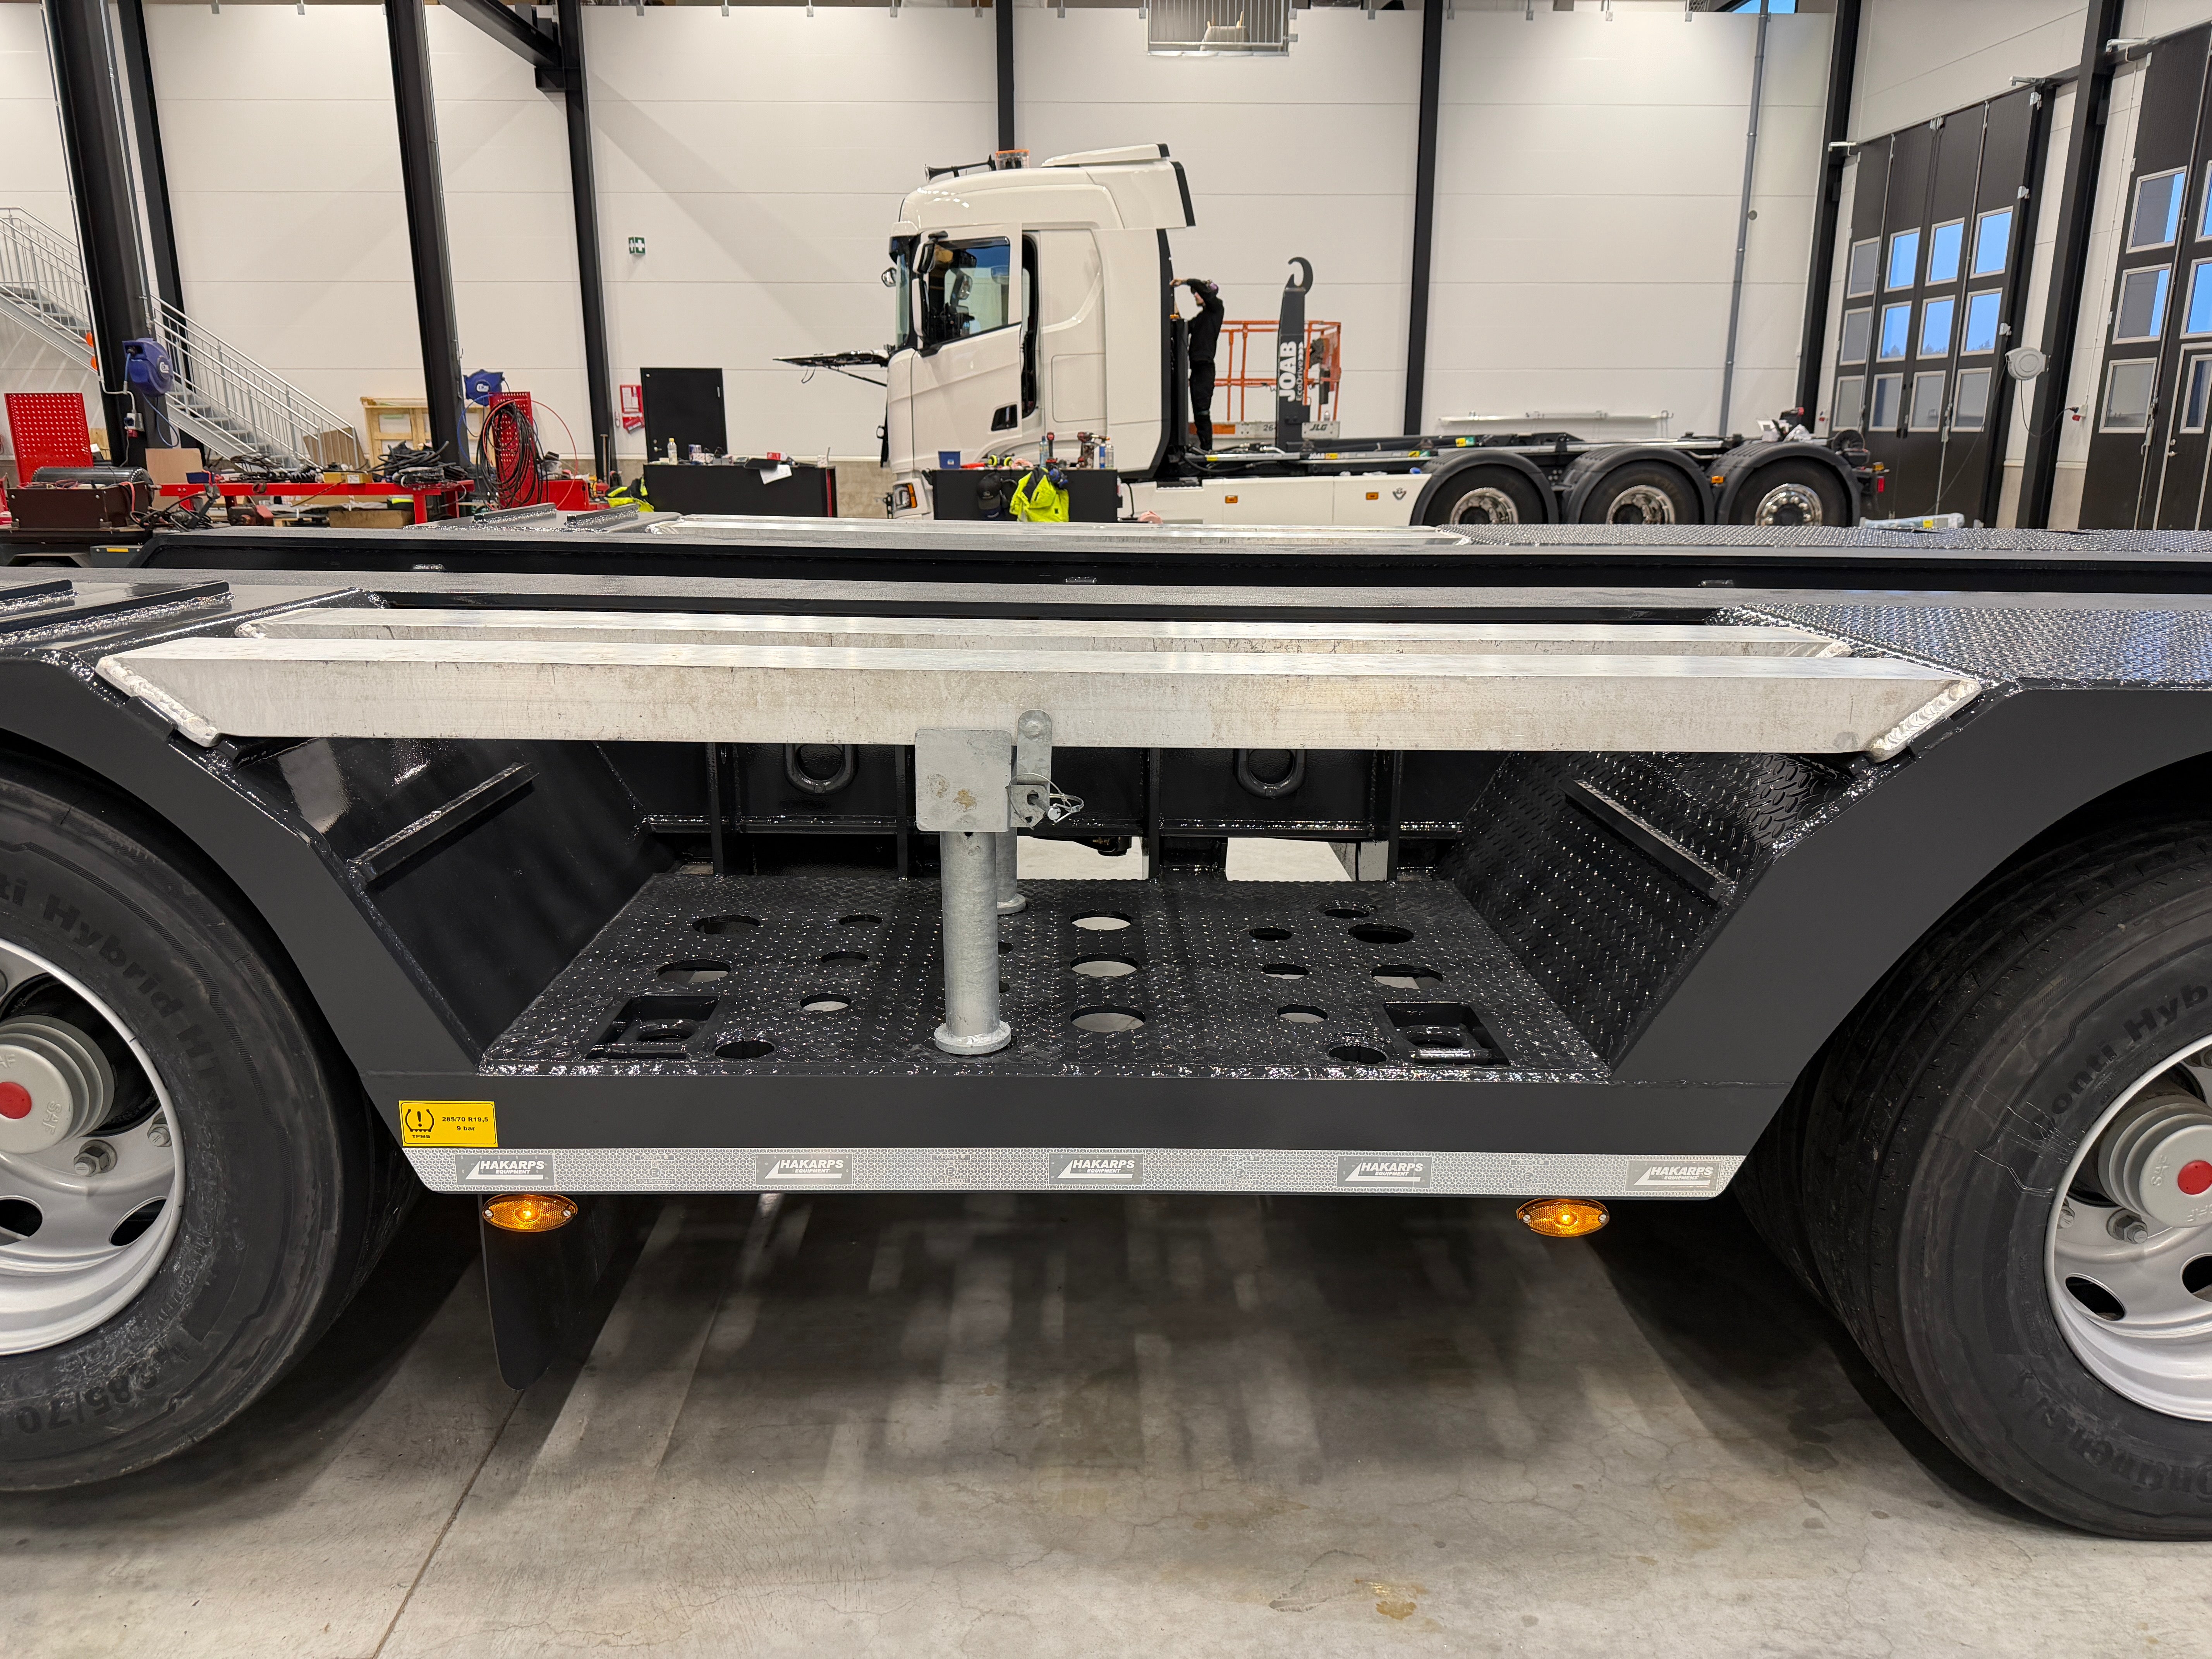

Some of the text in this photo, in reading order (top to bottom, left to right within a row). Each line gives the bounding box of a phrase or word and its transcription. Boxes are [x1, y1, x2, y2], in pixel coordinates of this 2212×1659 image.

[1279, 341, 1297, 402] JOAB
[43, 894, 184, 1018] Hybrid
[2123, 984, 2212, 1042] Hyb
[42, 1101, 62, 1135] SAF
[480, 1161, 544, 1170] HAKARPS
[780, 1160, 844, 1168] HAKARPS
[1072, 1160, 1135, 1168] HAKARPS
[1361, 1163, 1424, 1171] HAKARPS
[1650, 1166, 1714, 1176] HAKARPS
[2150, 1155, 2170, 1186] SAF
